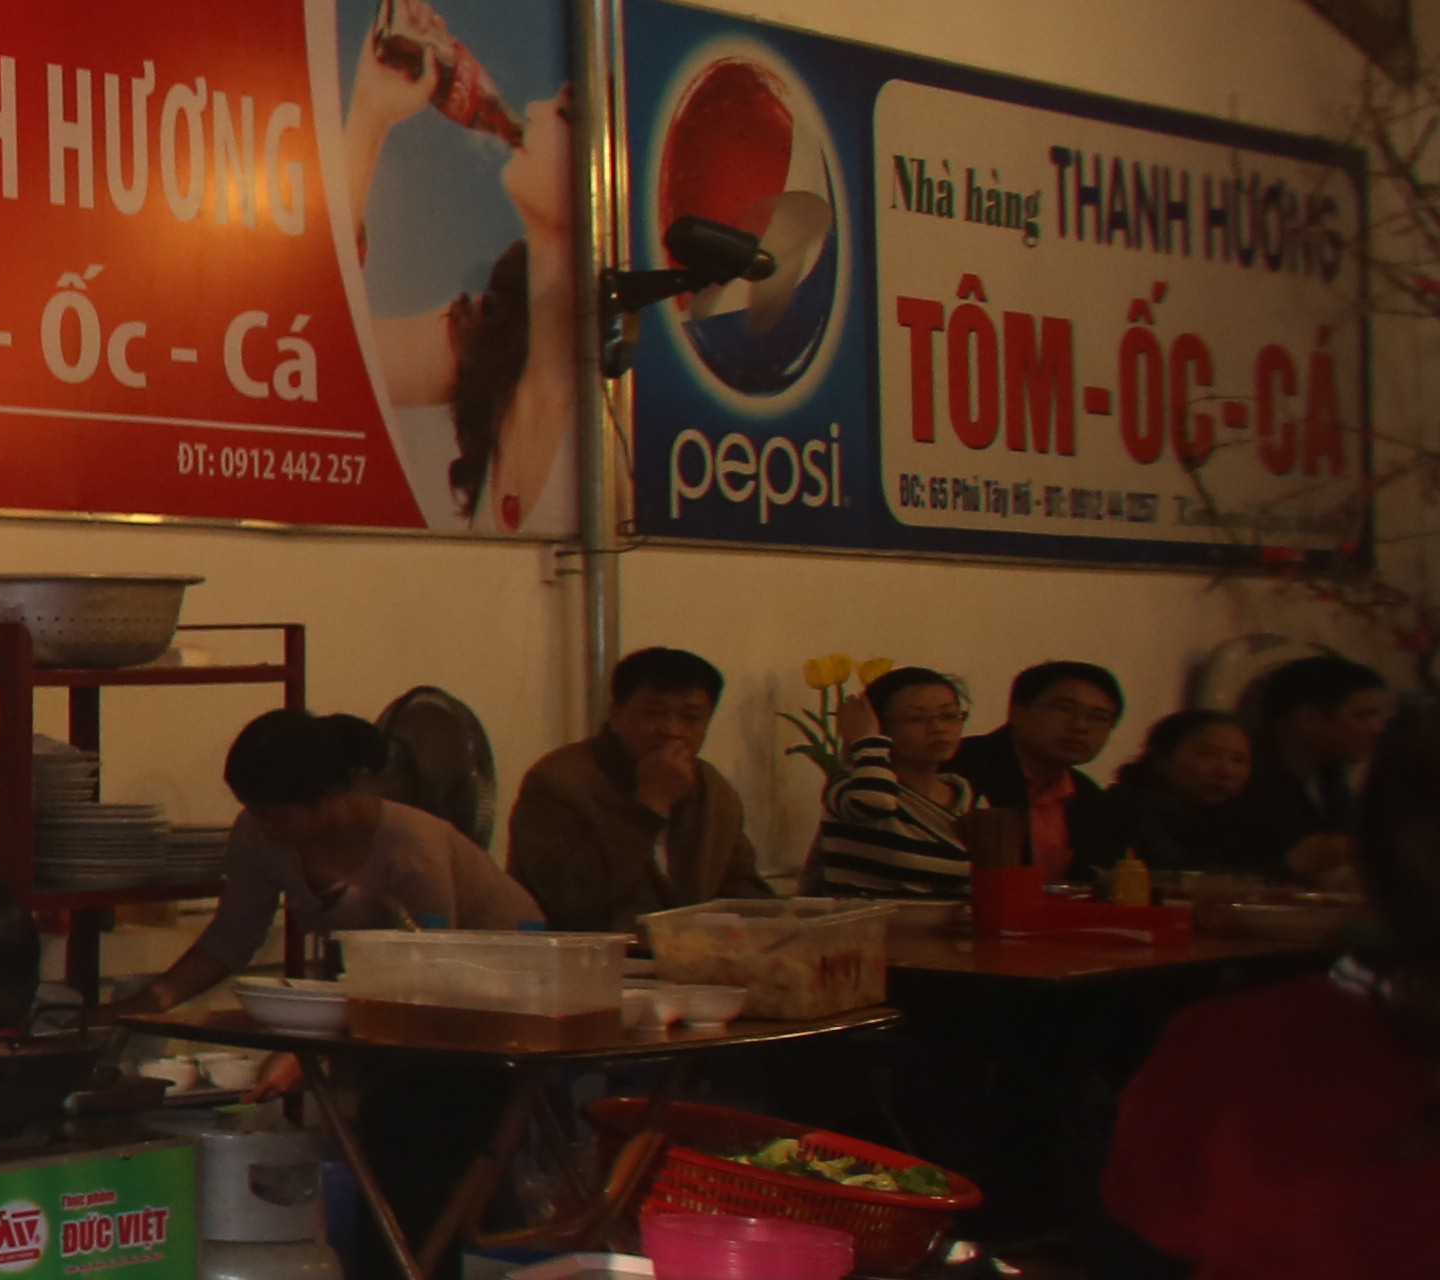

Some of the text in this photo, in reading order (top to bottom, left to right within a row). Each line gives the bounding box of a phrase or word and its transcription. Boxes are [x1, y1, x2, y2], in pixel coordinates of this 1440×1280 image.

[47, 59, 307, 237] HƯƠNG
[890, 153, 956, 220] Nhà
[965, 170, 1043, 250] hàng
[1051, 145, 1190, 258] THANH
[40, 263, 147, 389] Ốc
[223, 308, 319, 404] Cá
[176, 443, 216, 478] ĐT:
[220, 447, 277, 482] 0912
[281, 451, 325, 483] 442
[327, 454, 367, 486] 257
[670, 423, 844, 526] pepsi
[929, 476, 949, 511] 65
[61, 1207, 170, 1257] ĐỨC VIỆT
